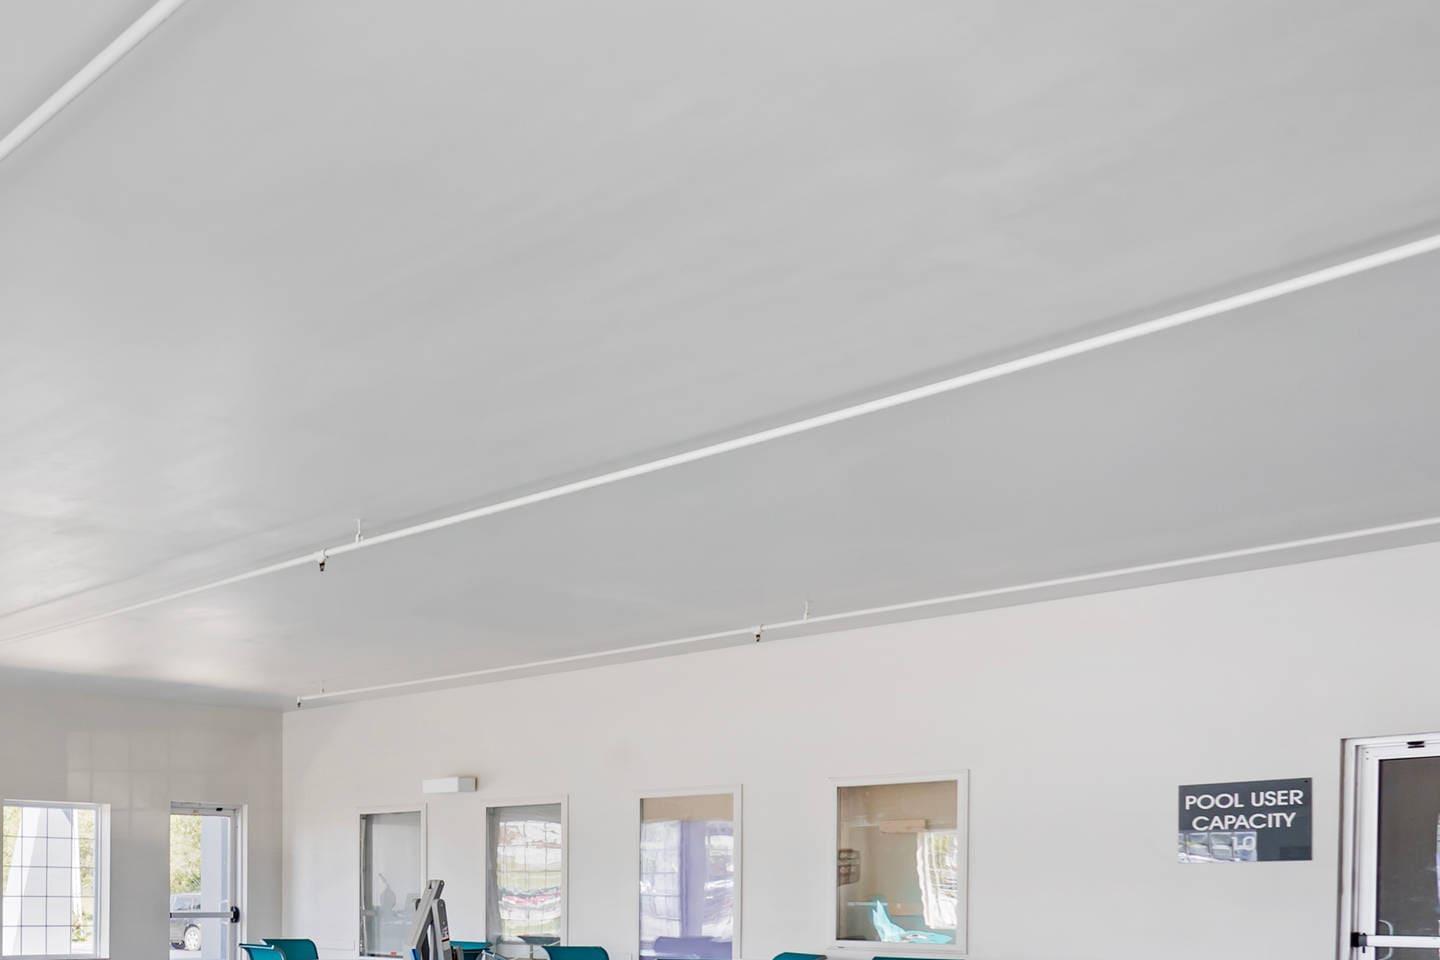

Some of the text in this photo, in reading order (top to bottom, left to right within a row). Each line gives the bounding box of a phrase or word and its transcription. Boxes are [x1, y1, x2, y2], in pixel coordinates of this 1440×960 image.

[1184, 789, 1304, 811] POOL USER
[1191, 811, 1297, 832] CAPACITY
